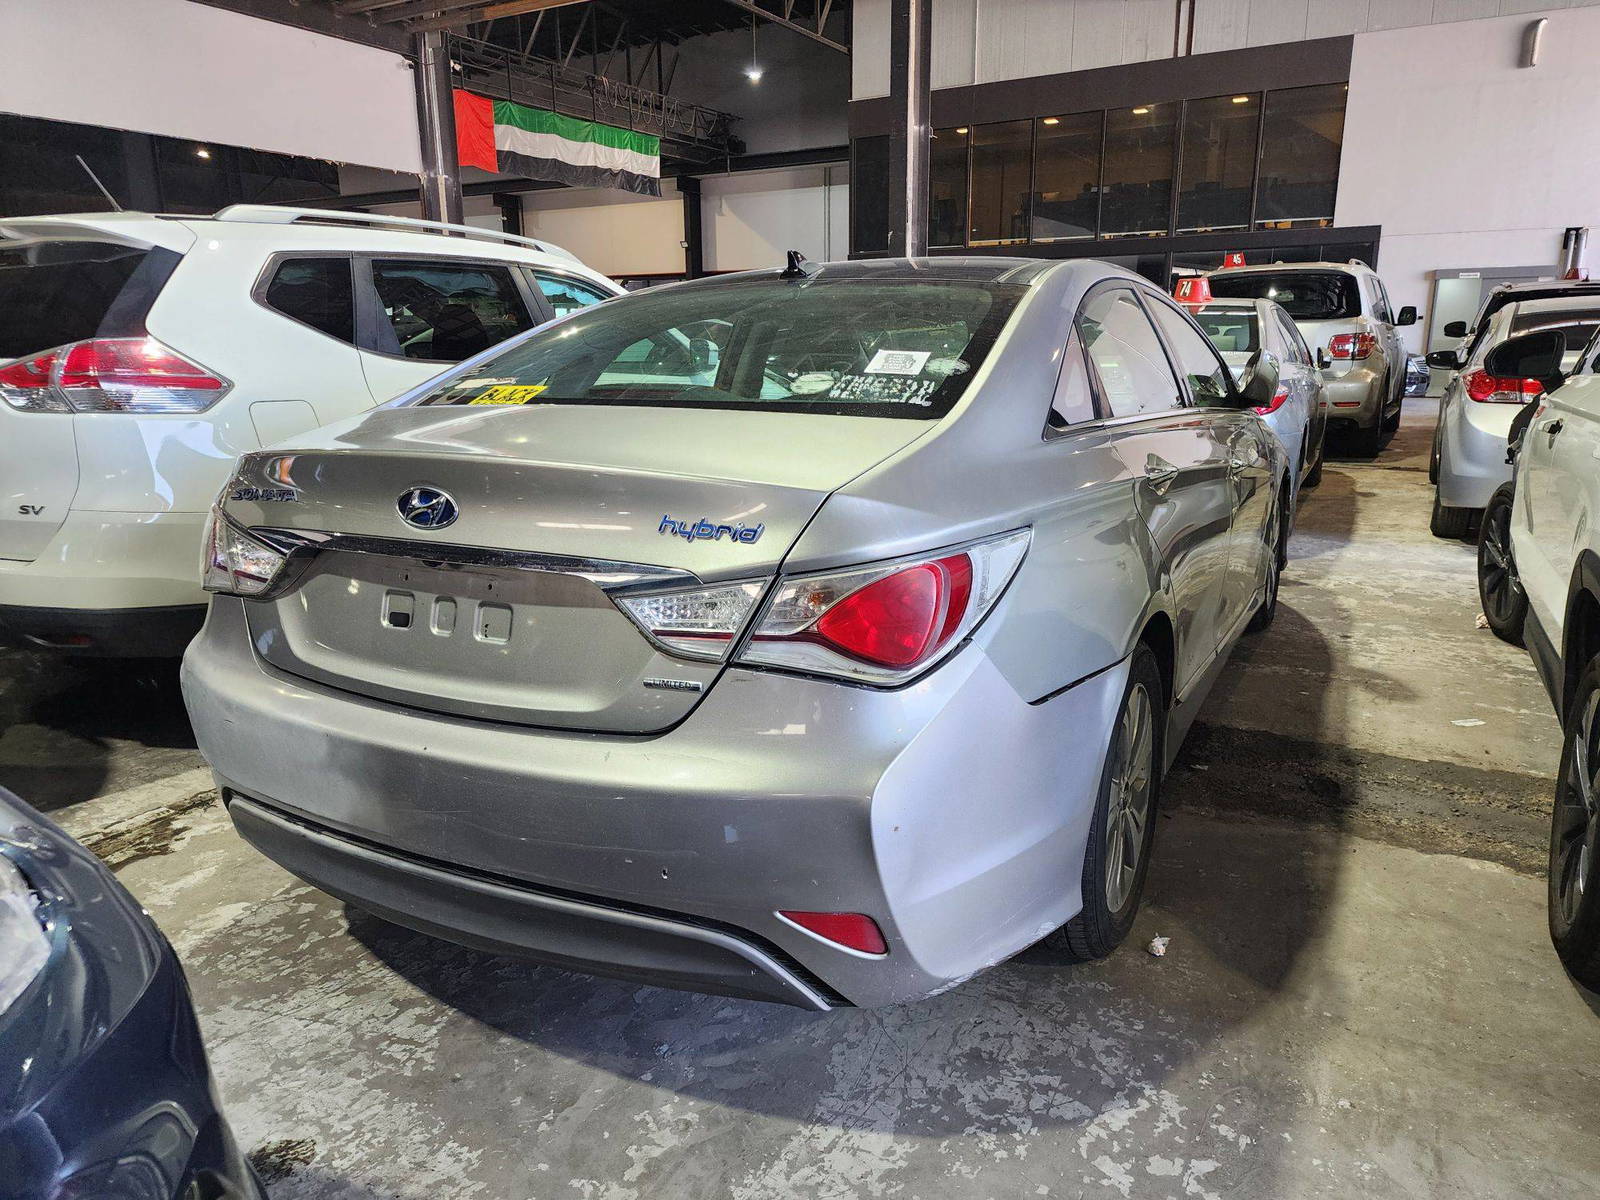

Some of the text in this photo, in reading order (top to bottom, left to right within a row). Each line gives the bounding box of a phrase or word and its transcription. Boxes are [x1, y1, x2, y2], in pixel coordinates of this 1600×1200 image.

[1232, 254, 1242, 265] 45
[1180, 281, 1192, 297] 74
[231, 487, 299, 502] SONATA
[18, 505, 45, 515] SV
[658, 514, 765, 544] hybrid
[651, 679, 693, 690] LIMITED
